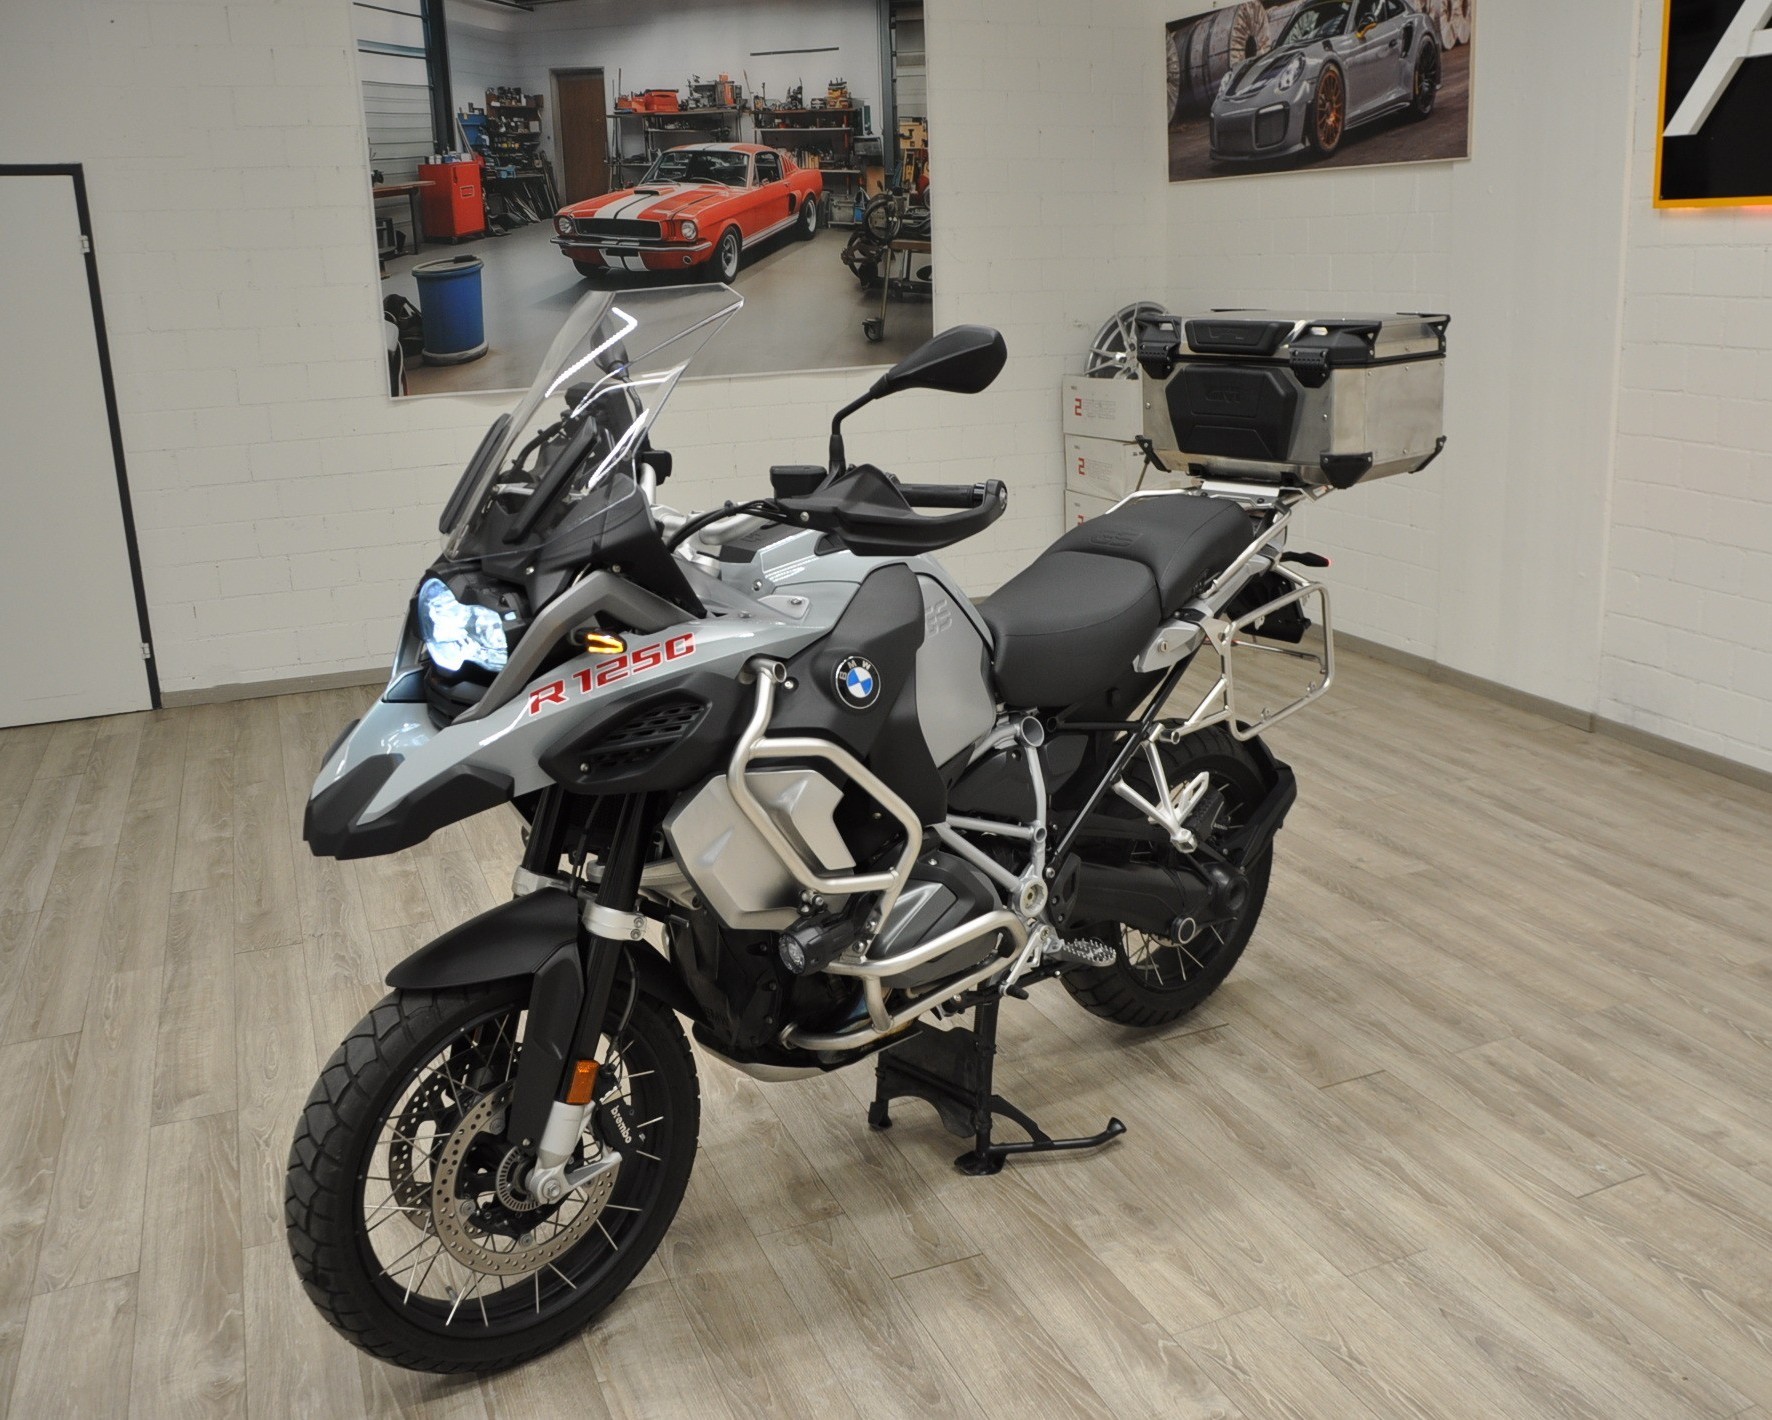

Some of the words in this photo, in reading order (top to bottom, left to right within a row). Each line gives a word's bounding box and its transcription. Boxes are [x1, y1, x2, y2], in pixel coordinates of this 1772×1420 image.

[839, 660, 871, 680] BMW
[530, 680, 568, 715] R
[611, 1105, 632, 1144] brembo
